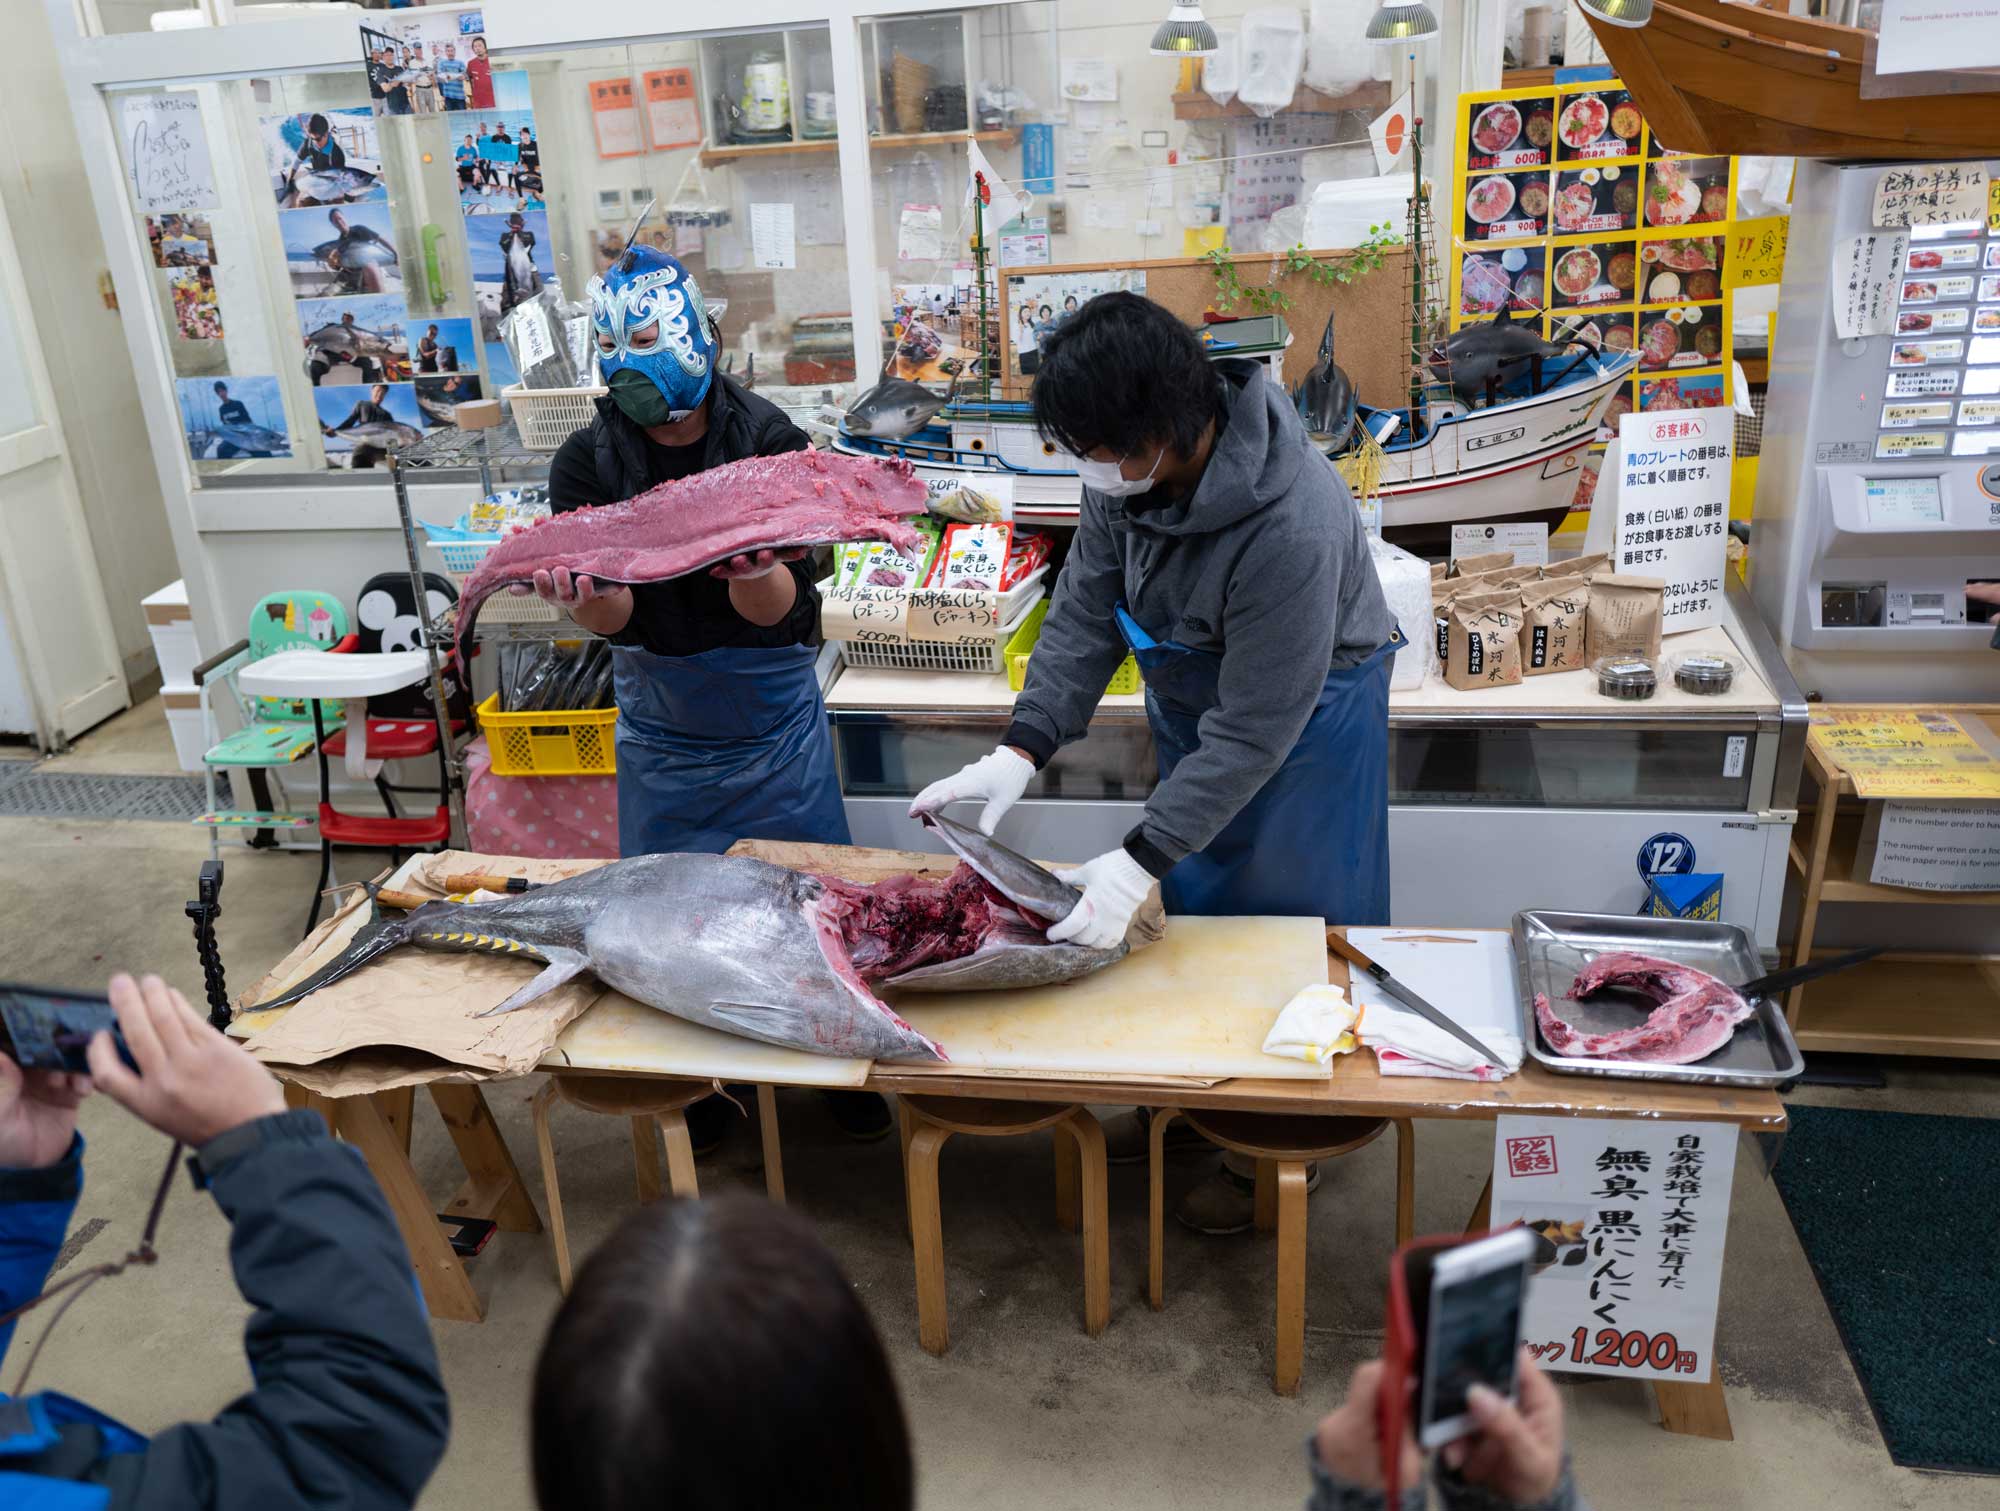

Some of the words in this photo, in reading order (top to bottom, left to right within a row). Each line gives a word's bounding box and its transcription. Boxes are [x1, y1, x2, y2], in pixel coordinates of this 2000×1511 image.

[1515, 152, 1546, 165] 600円
[1518, 221, 1544, 230] 900円
[1655, 423, 1701, 439] お客様へ
[1627, 446, 1731, 467] 青のプレートの番号は、
[1626, 467, 1710, 487] 席に着く順番です。
[1624, 522, 1722, 546] がお食事をお渡しする
[964, 553, 988, 564] 赤身
[1623, 549, 1668, 566] 番号です。
[950, 563, 997, 574] 塩くじら
[857, 630, 900, 643] 500円
[957, 635, 996, 645] 500円
[1471, 635, 1480, 672] ひとめぼれ
[1535, 630, 1545, 664] はえぬき
[1905, 805, 1939, 813] number
[1940, 807, 1971, 815] written
[1915, 819, 1948, 827] number
[1900, 843, 1933, 852] number
[1936, 846, 1966, 854] written
[1650, 843, 1683, 872] 12
[1913, 857, 1937, 866] paper
[1969, 859, 1981, 867] for
[1881, 876, 1905, 885] Thank
[1908, 880, 1923, 889] you
[1940, 882, 1959, 890] your
[1657, 1134, 1705, 1290] 自家栽培で大事に育てた
